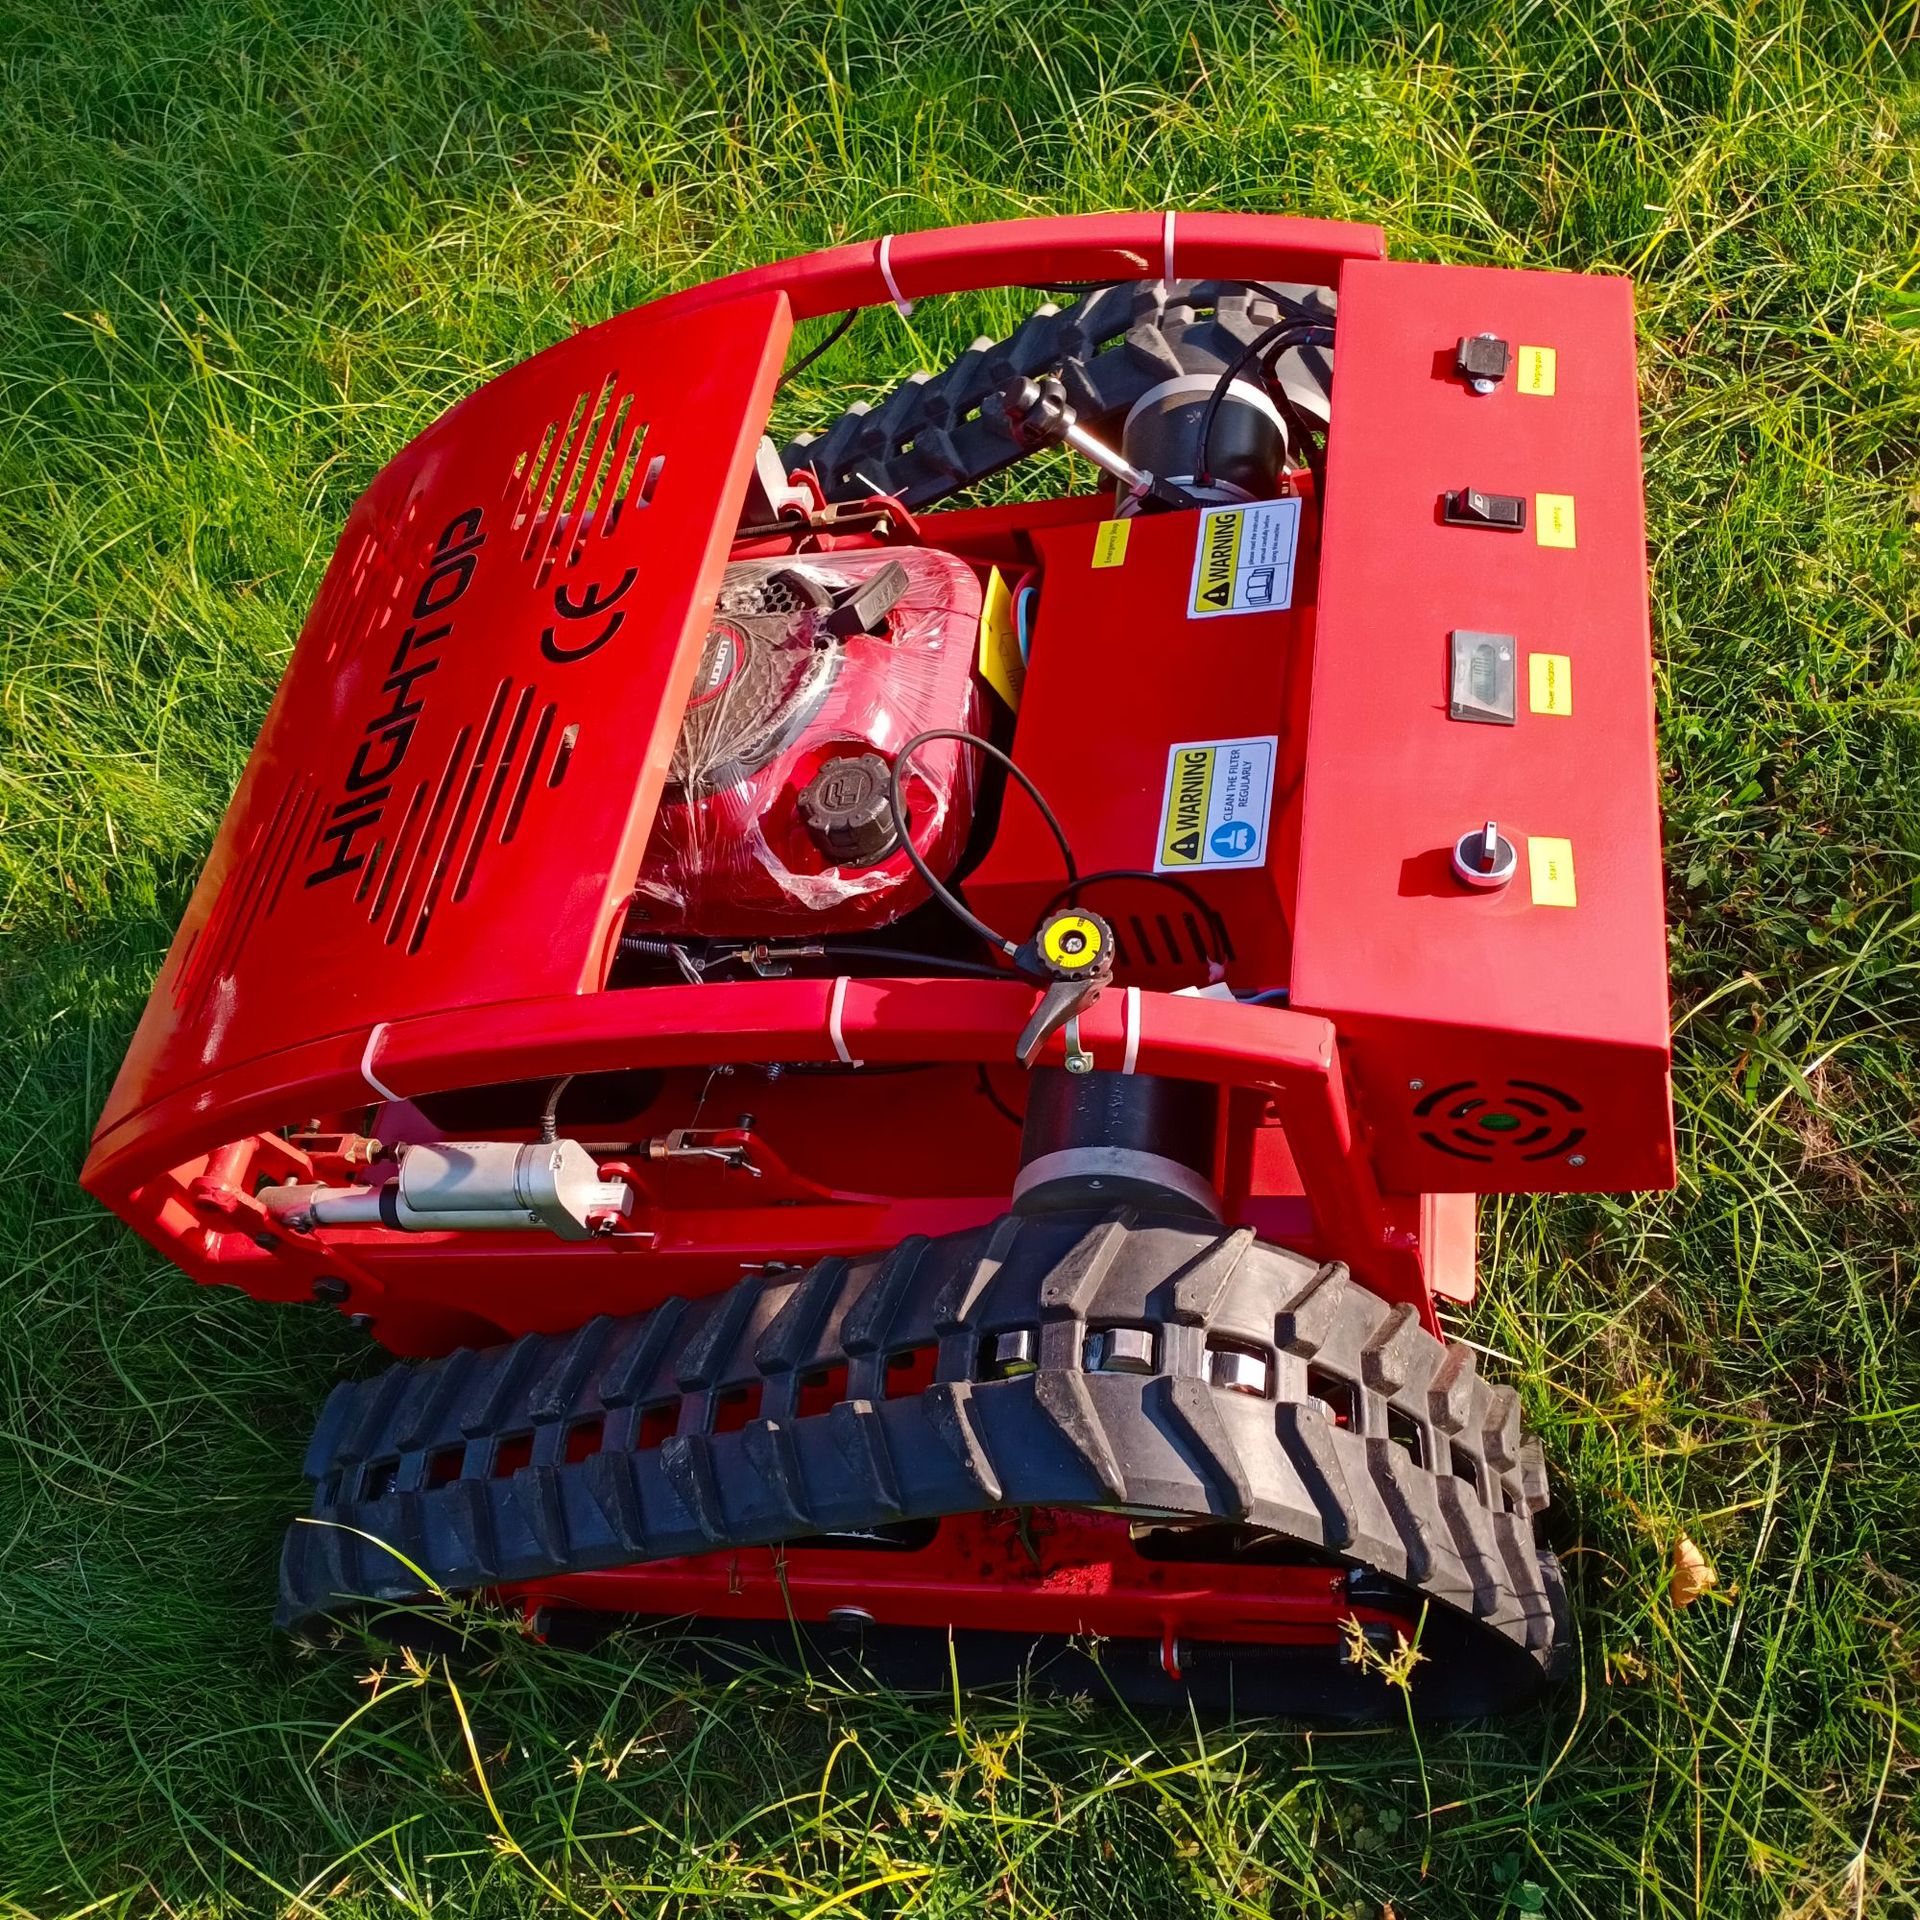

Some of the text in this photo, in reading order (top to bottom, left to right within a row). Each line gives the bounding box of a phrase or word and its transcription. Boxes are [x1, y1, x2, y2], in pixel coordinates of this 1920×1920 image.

[1104, 523, 1119, 564] Emergency Stop
[1252, 510, 1260, 532] instruction
[1261, 530, 1270, 547] carefully
[1207, 514, 1237, 582] WARNING
[1271, 551, 1279, 562] using
[540, 566, 639, 664] CE
[304, 505, 487, 888] HIGHTOP
[1175, 751, 1208, 832] WARNING
[1223, 749, 1241, 822] CLEAN THE FILTER
[1238, 760, 1252, 808] REGULARLY
[1548, 860, 1558, 881] Start
